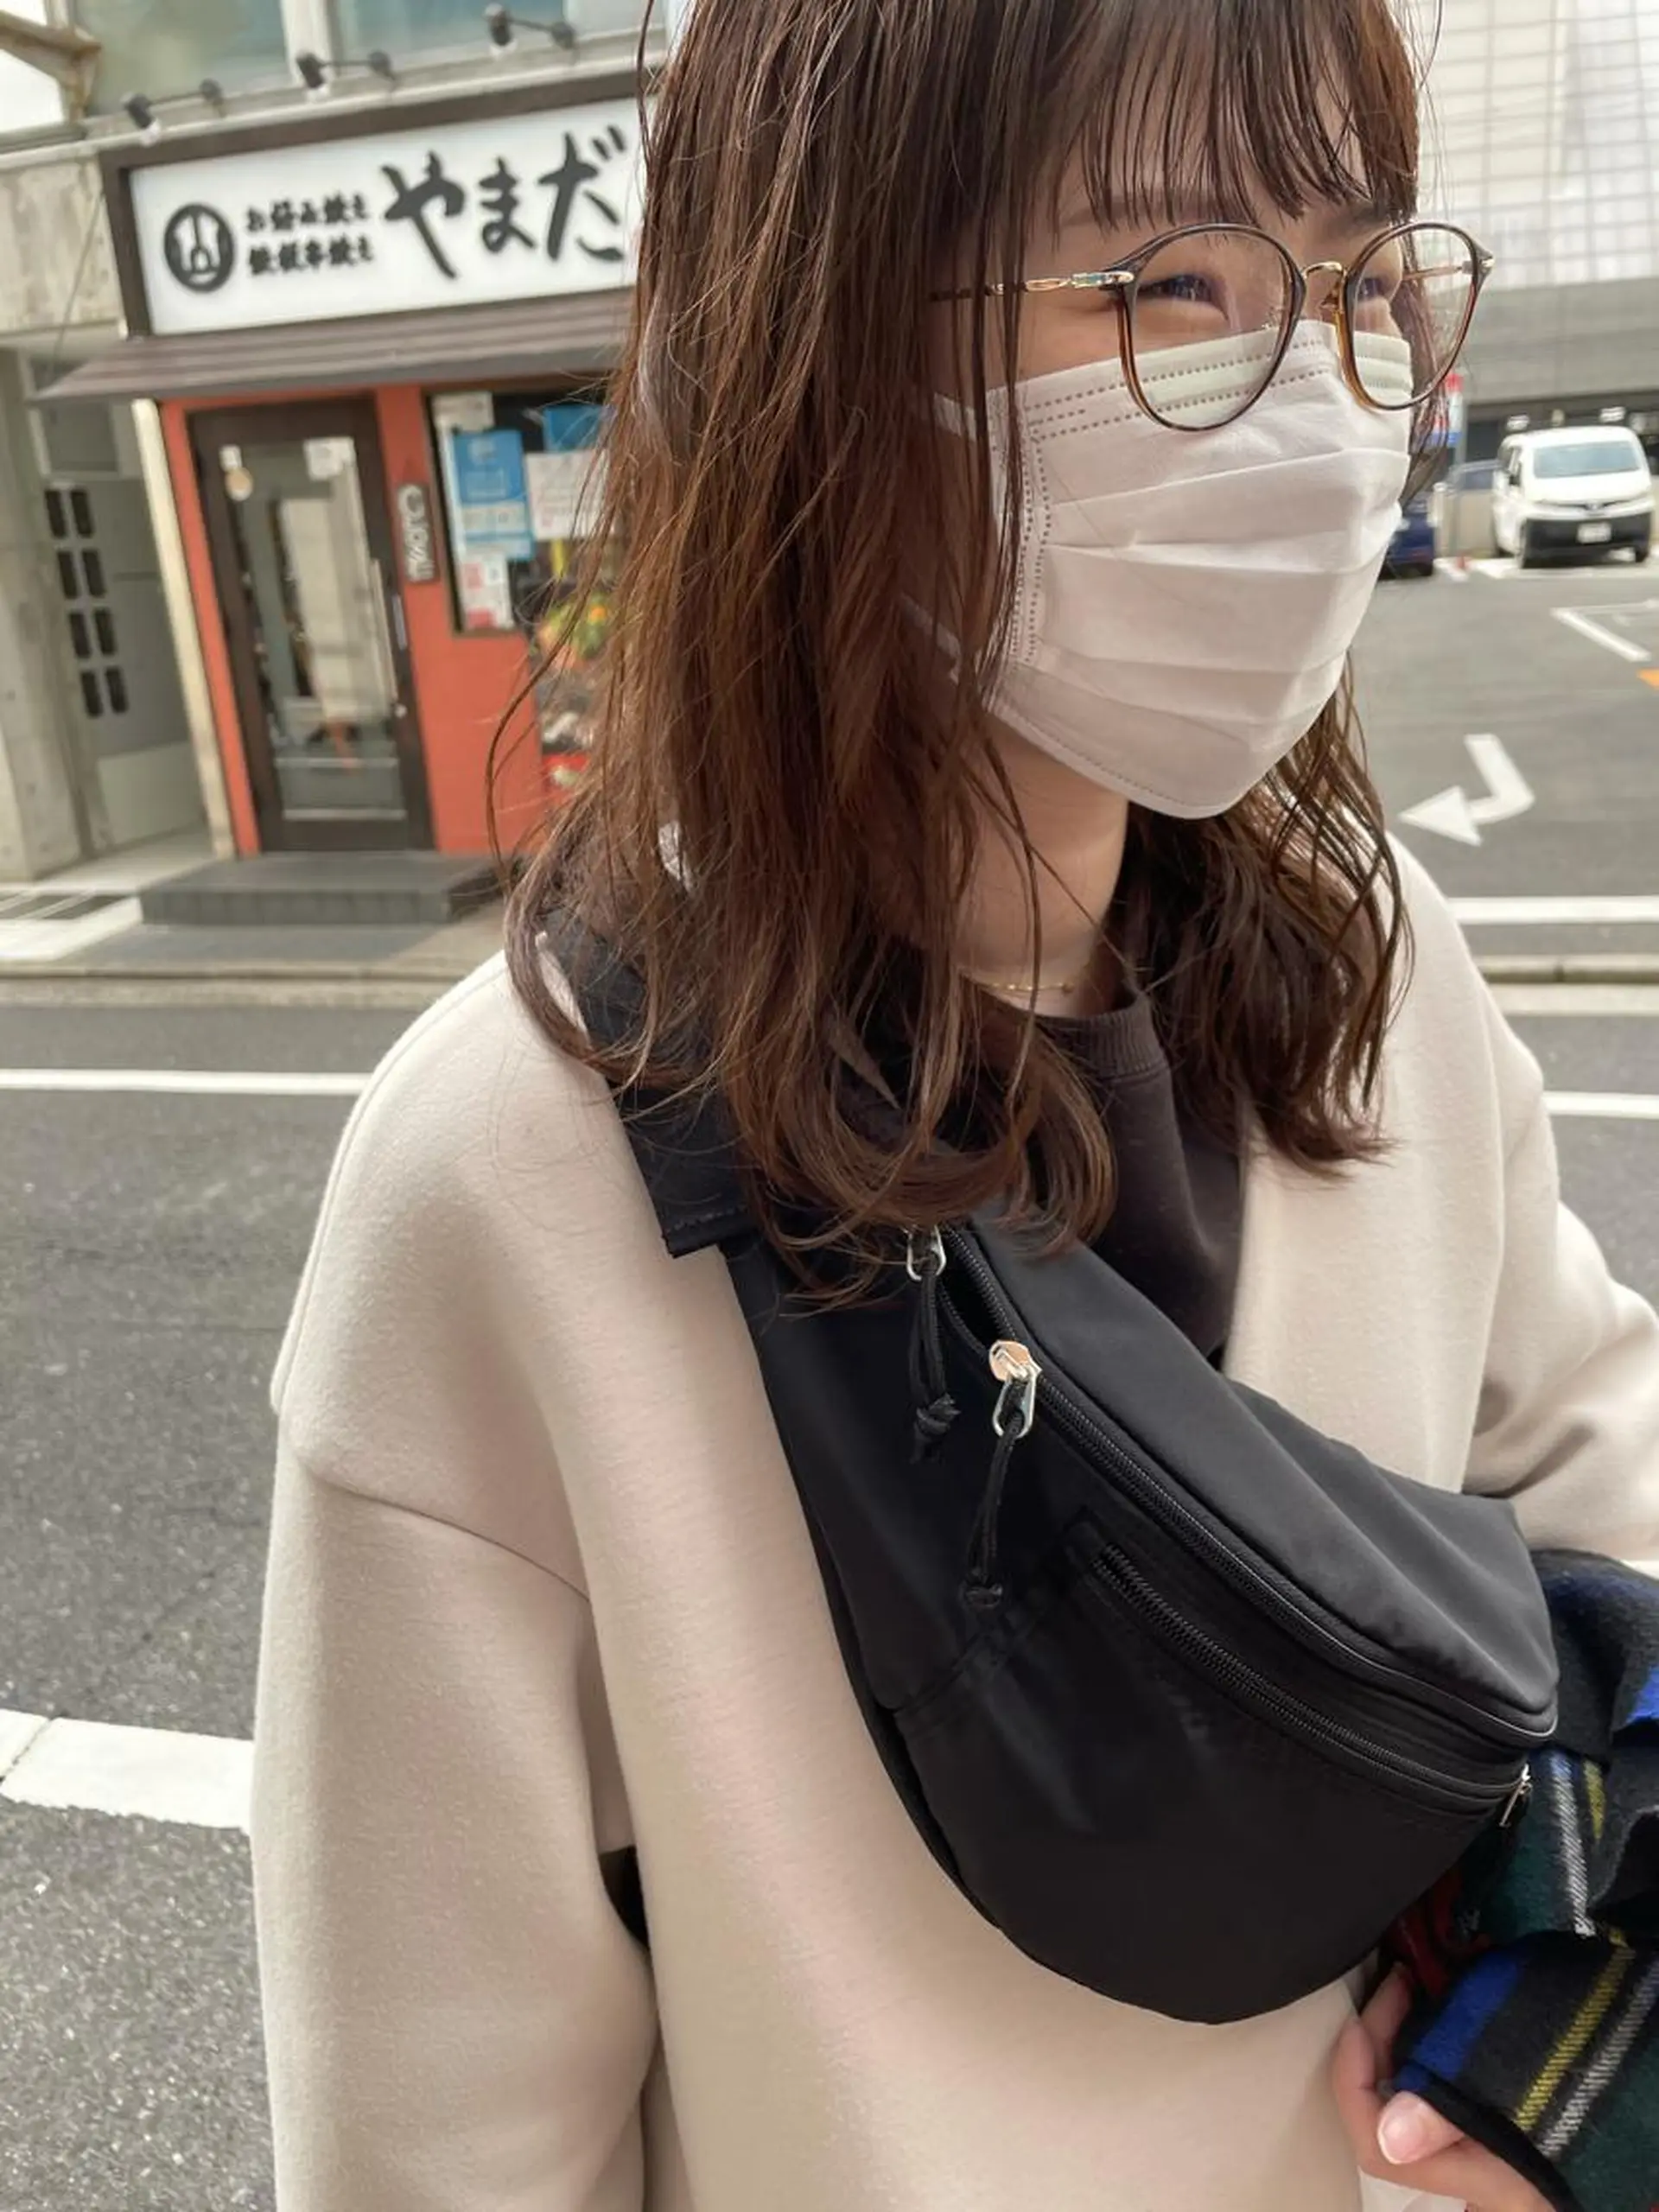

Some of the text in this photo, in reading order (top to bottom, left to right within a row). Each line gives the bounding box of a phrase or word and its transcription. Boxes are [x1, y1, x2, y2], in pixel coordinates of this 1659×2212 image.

[247, 189, 367, 232] お好み焼き
[380, 125, 626, 280] やまだ
